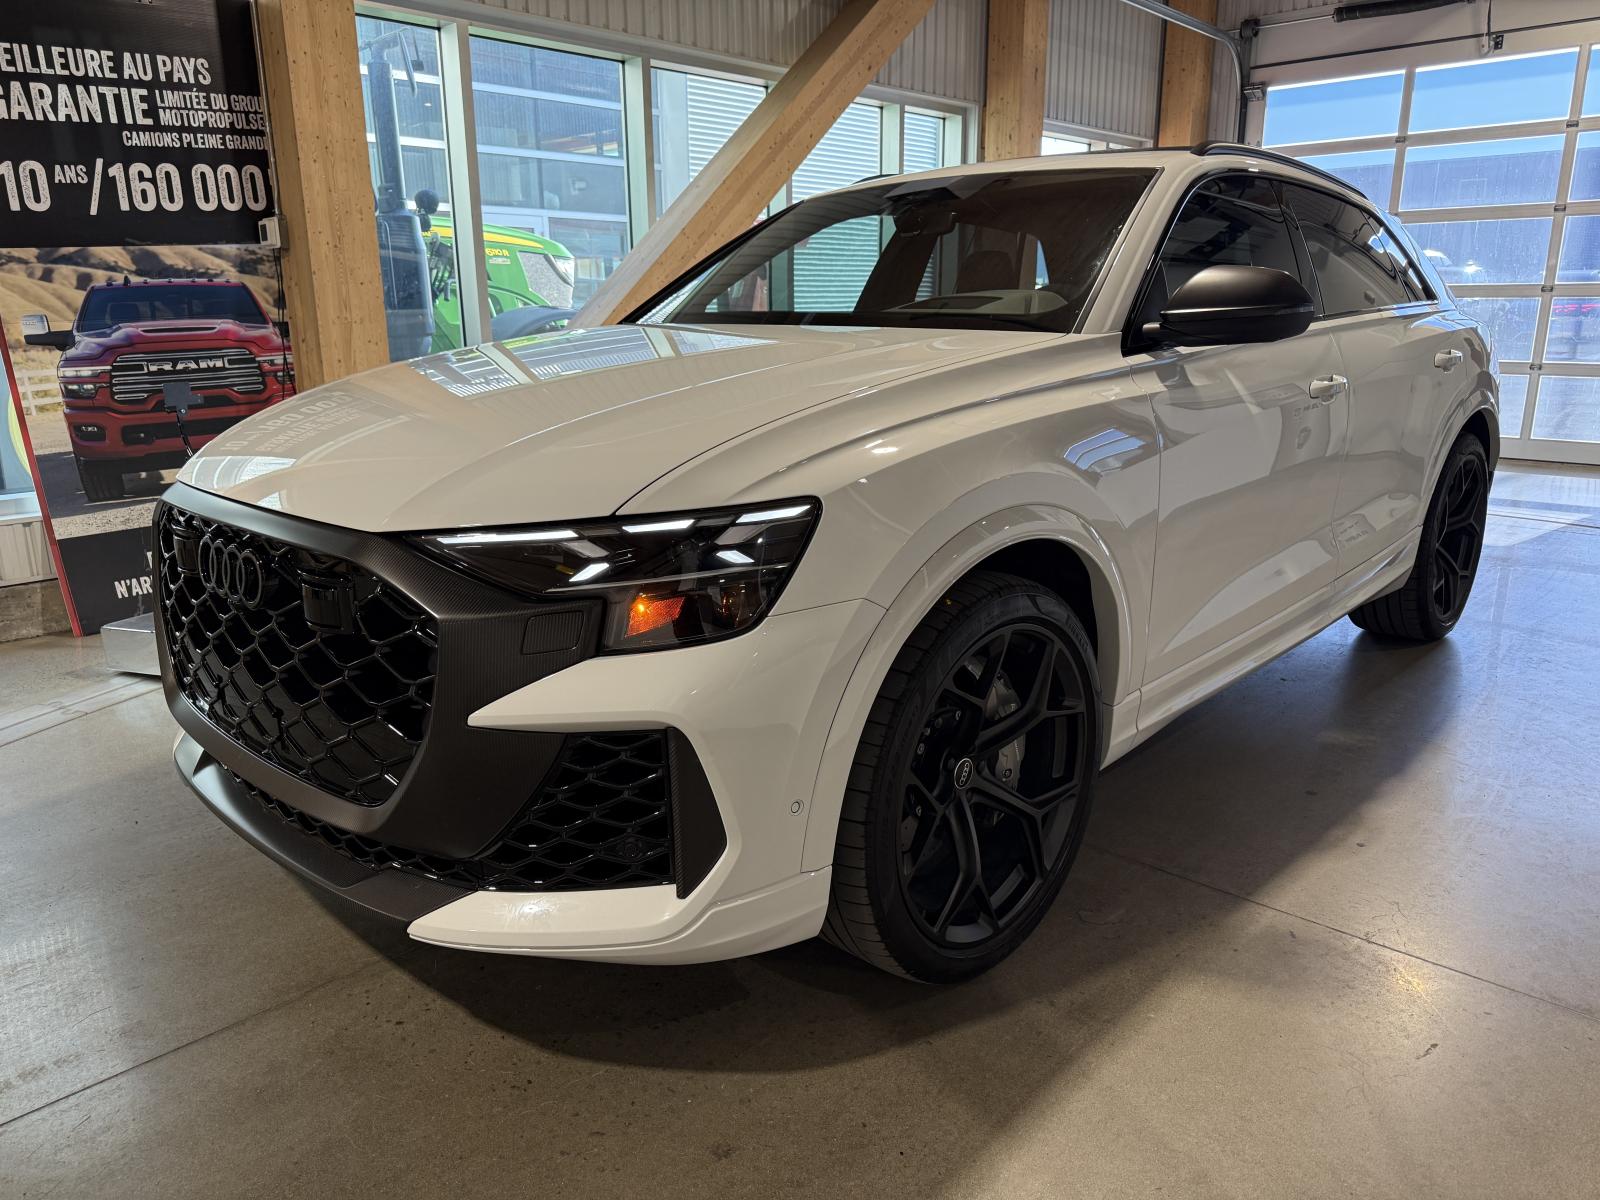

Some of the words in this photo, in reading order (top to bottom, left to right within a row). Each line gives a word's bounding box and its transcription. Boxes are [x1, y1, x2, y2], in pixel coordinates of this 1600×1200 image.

[123, 51, 153, 81] AU
[156, 54, 212, 85] PAYS
[155, 88, 208, 110] LIMITÉE
[210, 93, 228, 111] DU
[122, 130, 181, 149] CAMIONS
[183, 132, 225, 149] PLEINE
[191, 164, 268, 212] 000
[148, 358, 224, 371] RAM
[114, 573, 153, 599] N'AR
